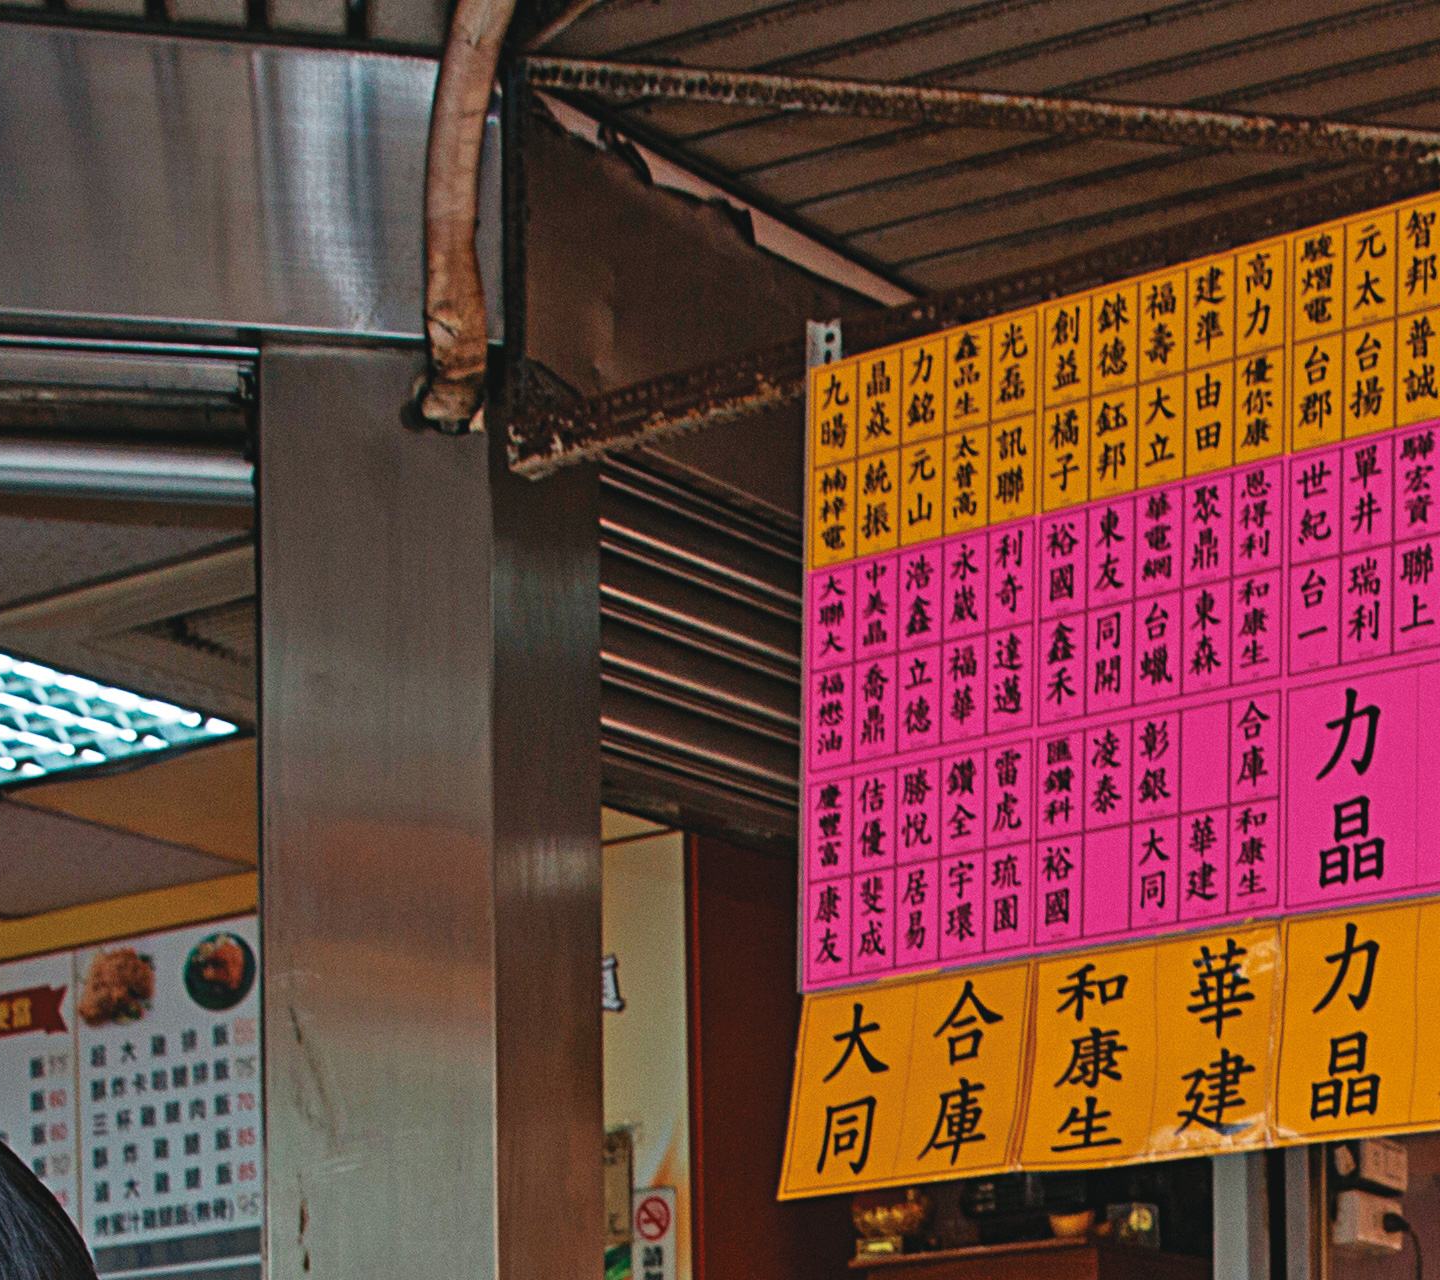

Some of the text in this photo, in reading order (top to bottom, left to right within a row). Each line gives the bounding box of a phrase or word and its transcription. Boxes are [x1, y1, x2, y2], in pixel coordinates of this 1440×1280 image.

[1297, 461, 1332, 545] 世紀
[1350, 446, 1381, 534] 單井
[1400, 543, 1434, 633] 聯上
[1316, 688, 1386, 888] 力晶
[816, 1002, 889, 1175] 大同
[917, 980, 1003, 1166] 合庫
[1051, 964, 1129, 1154] 和康生
[1174, 938, 1256, 1138] 華建
[1311, 922, 1381, 1122] 力晶
